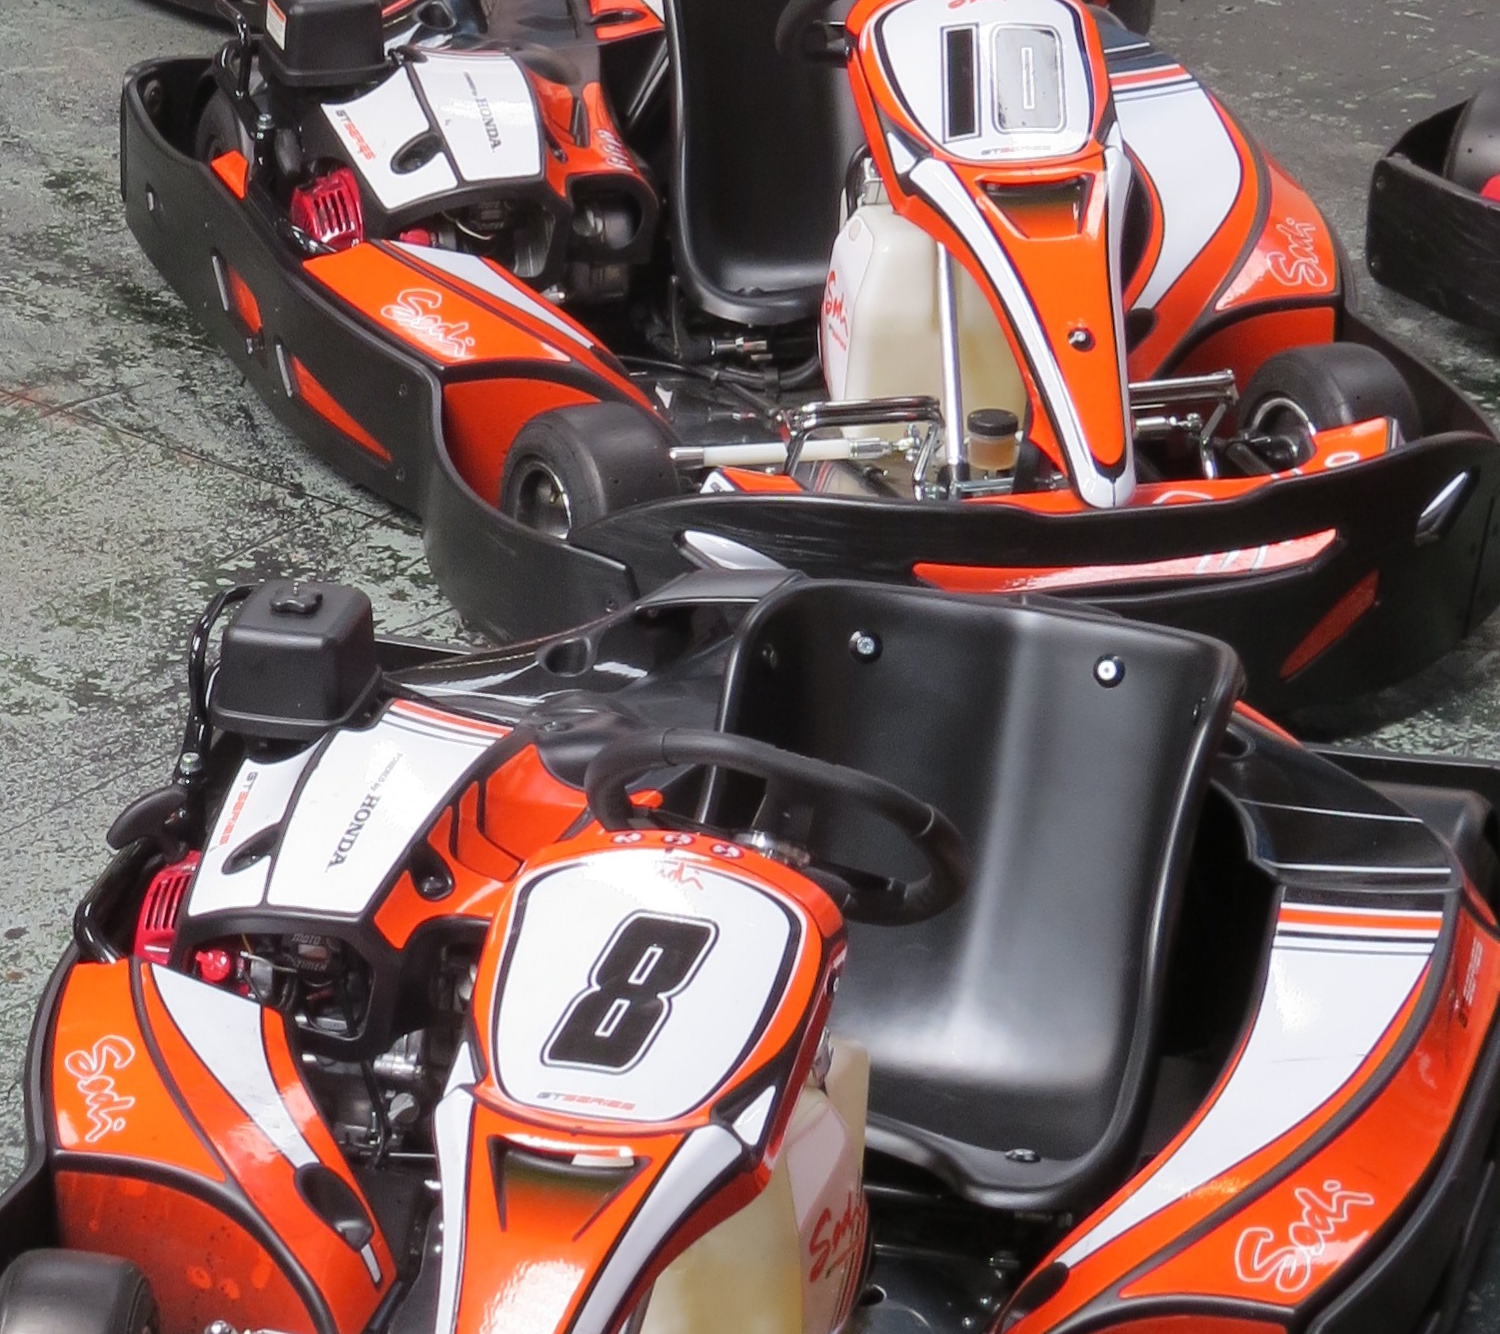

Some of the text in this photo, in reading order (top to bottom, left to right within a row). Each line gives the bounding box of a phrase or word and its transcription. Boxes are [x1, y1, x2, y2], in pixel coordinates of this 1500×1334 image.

[474, 96, 503, 153] HONDA
[940, 22, 1068, 145] 10
[1276, 217, 1329, 287] Sodi
[380, 287, 476, 357] Sodi
[327, 793, 382, 869] HONDA
[539, 908, 720, 1076] 8
[64, 1034, 137, 1143] Sodi
[1233, 1179, 1375, 1294] Sodi
